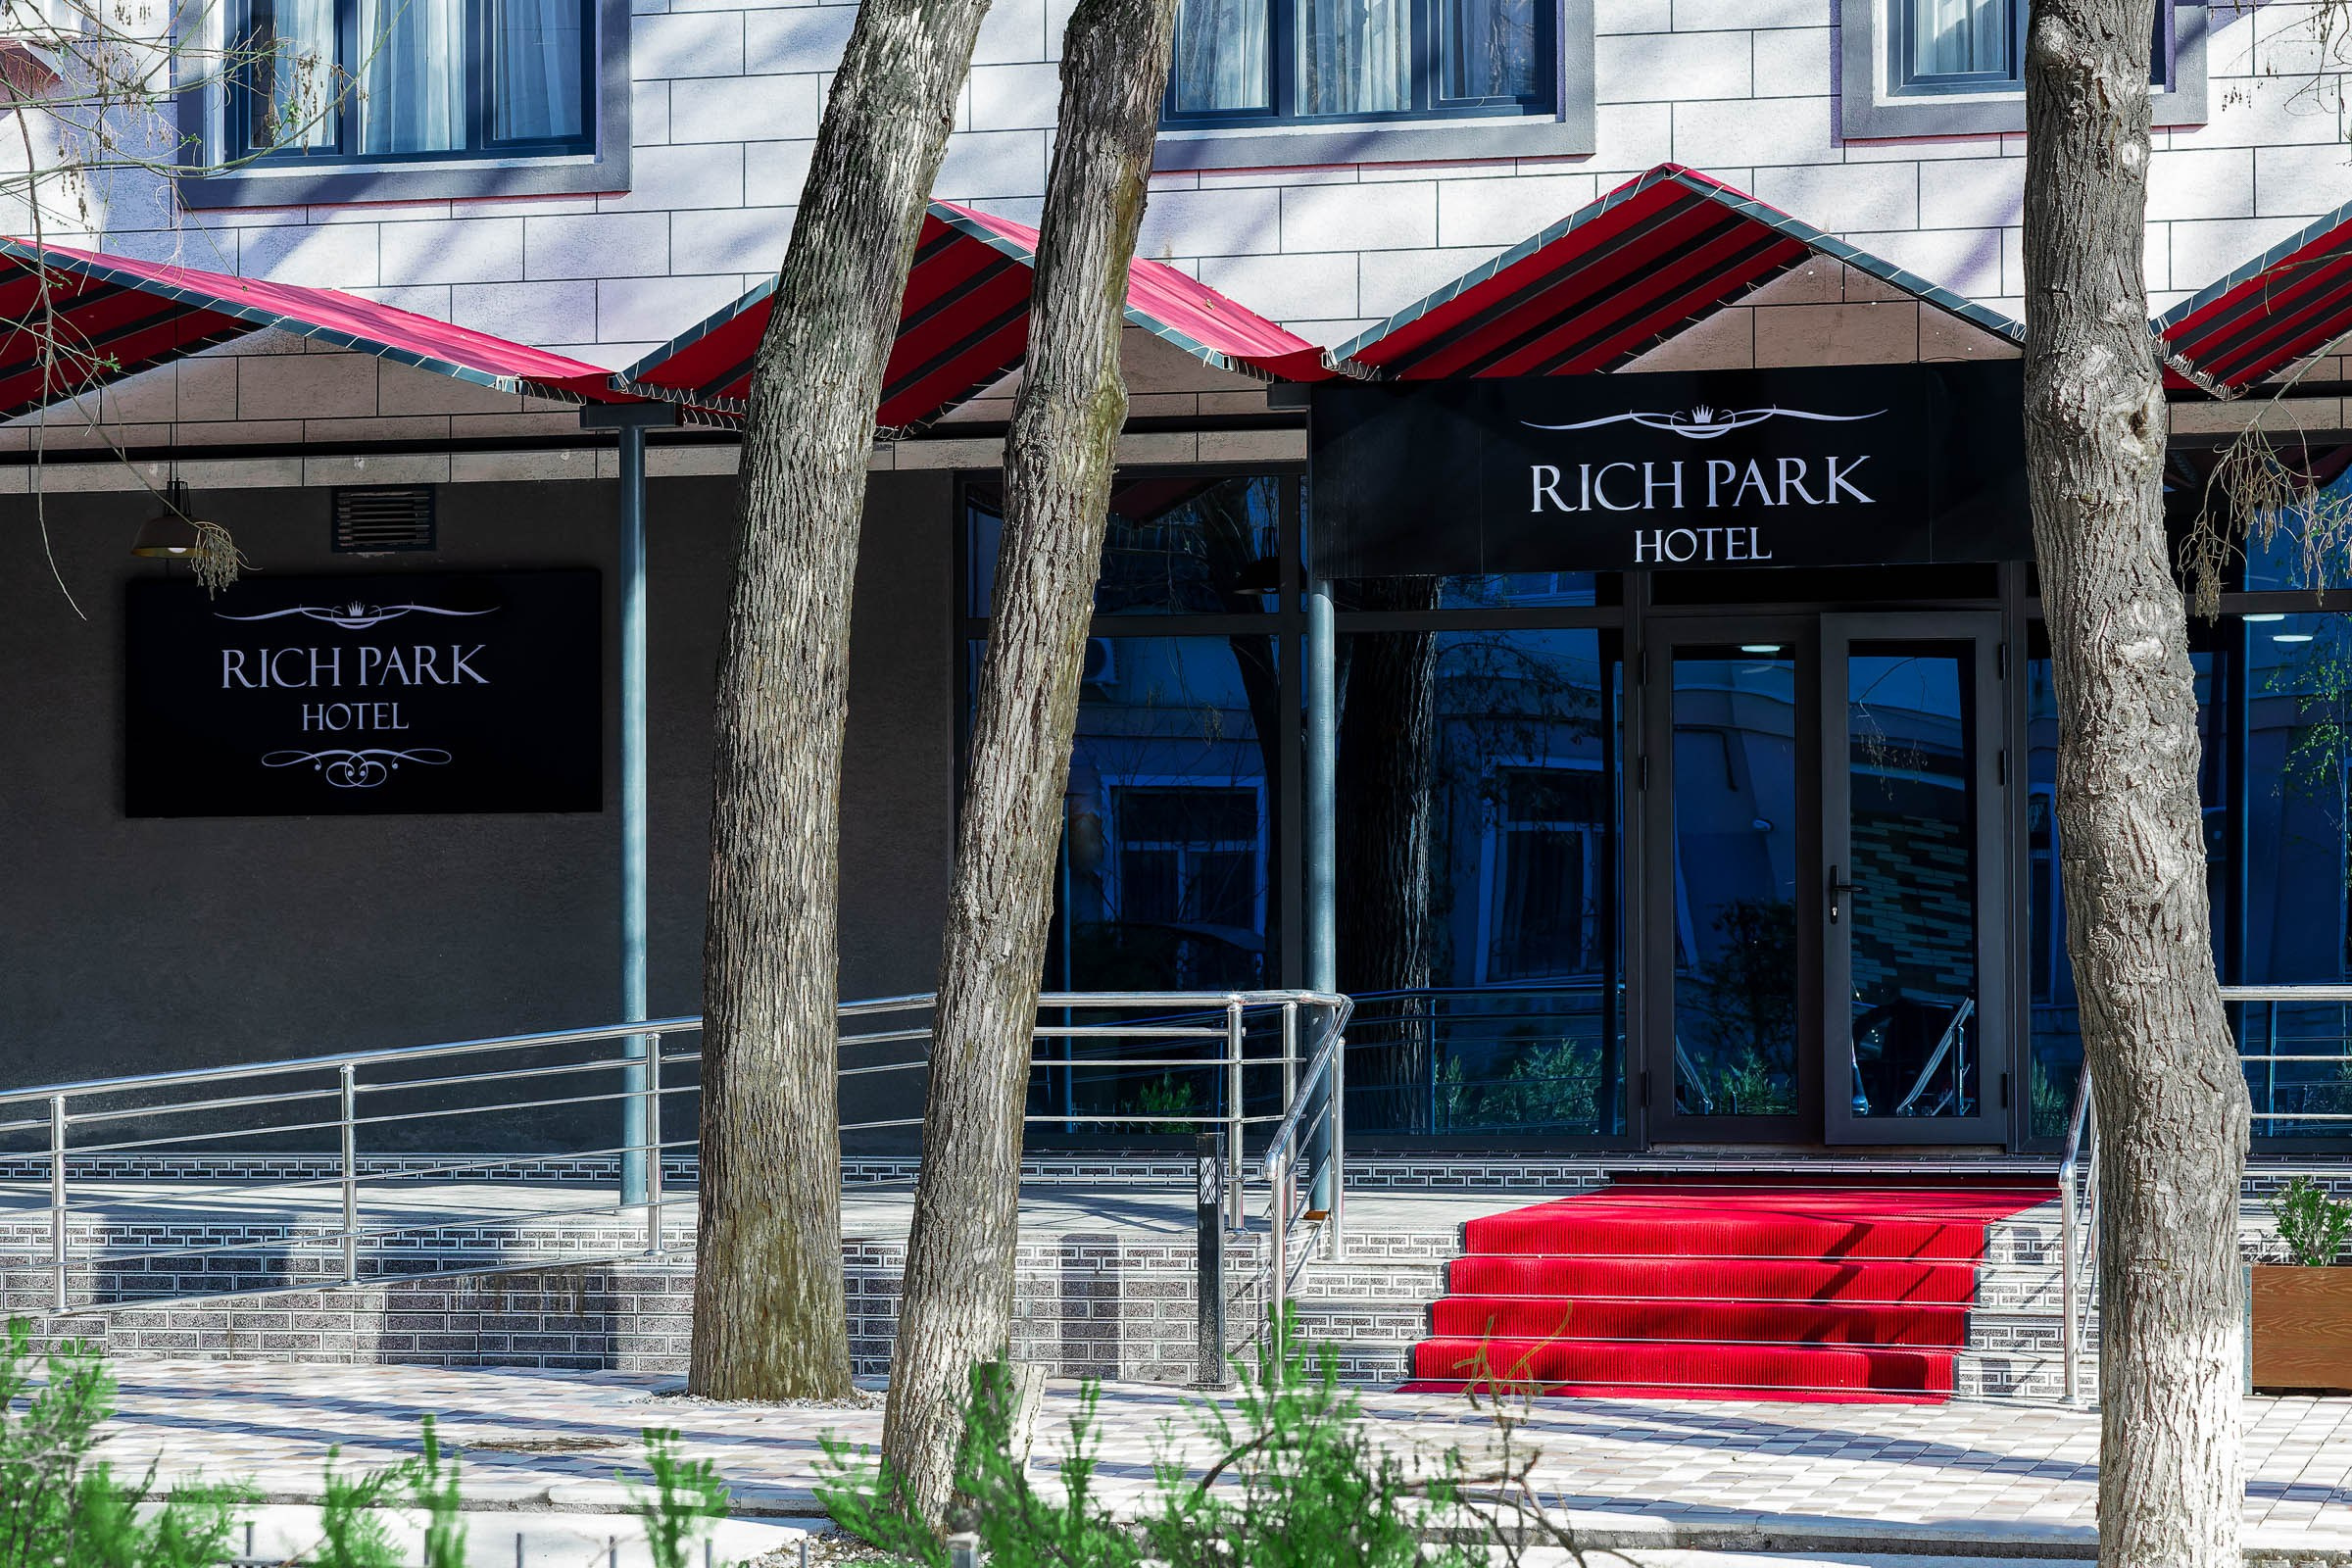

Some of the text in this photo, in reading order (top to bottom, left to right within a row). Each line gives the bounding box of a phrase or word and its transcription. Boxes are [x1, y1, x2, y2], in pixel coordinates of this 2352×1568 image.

[1531, 456, 1876, 512] RICH PARK
[1635, 527, 1772, 563] HOTEL
[222, 645, 489, 688] RICH PARK
[302, 703, 409, 730] HOTEL
